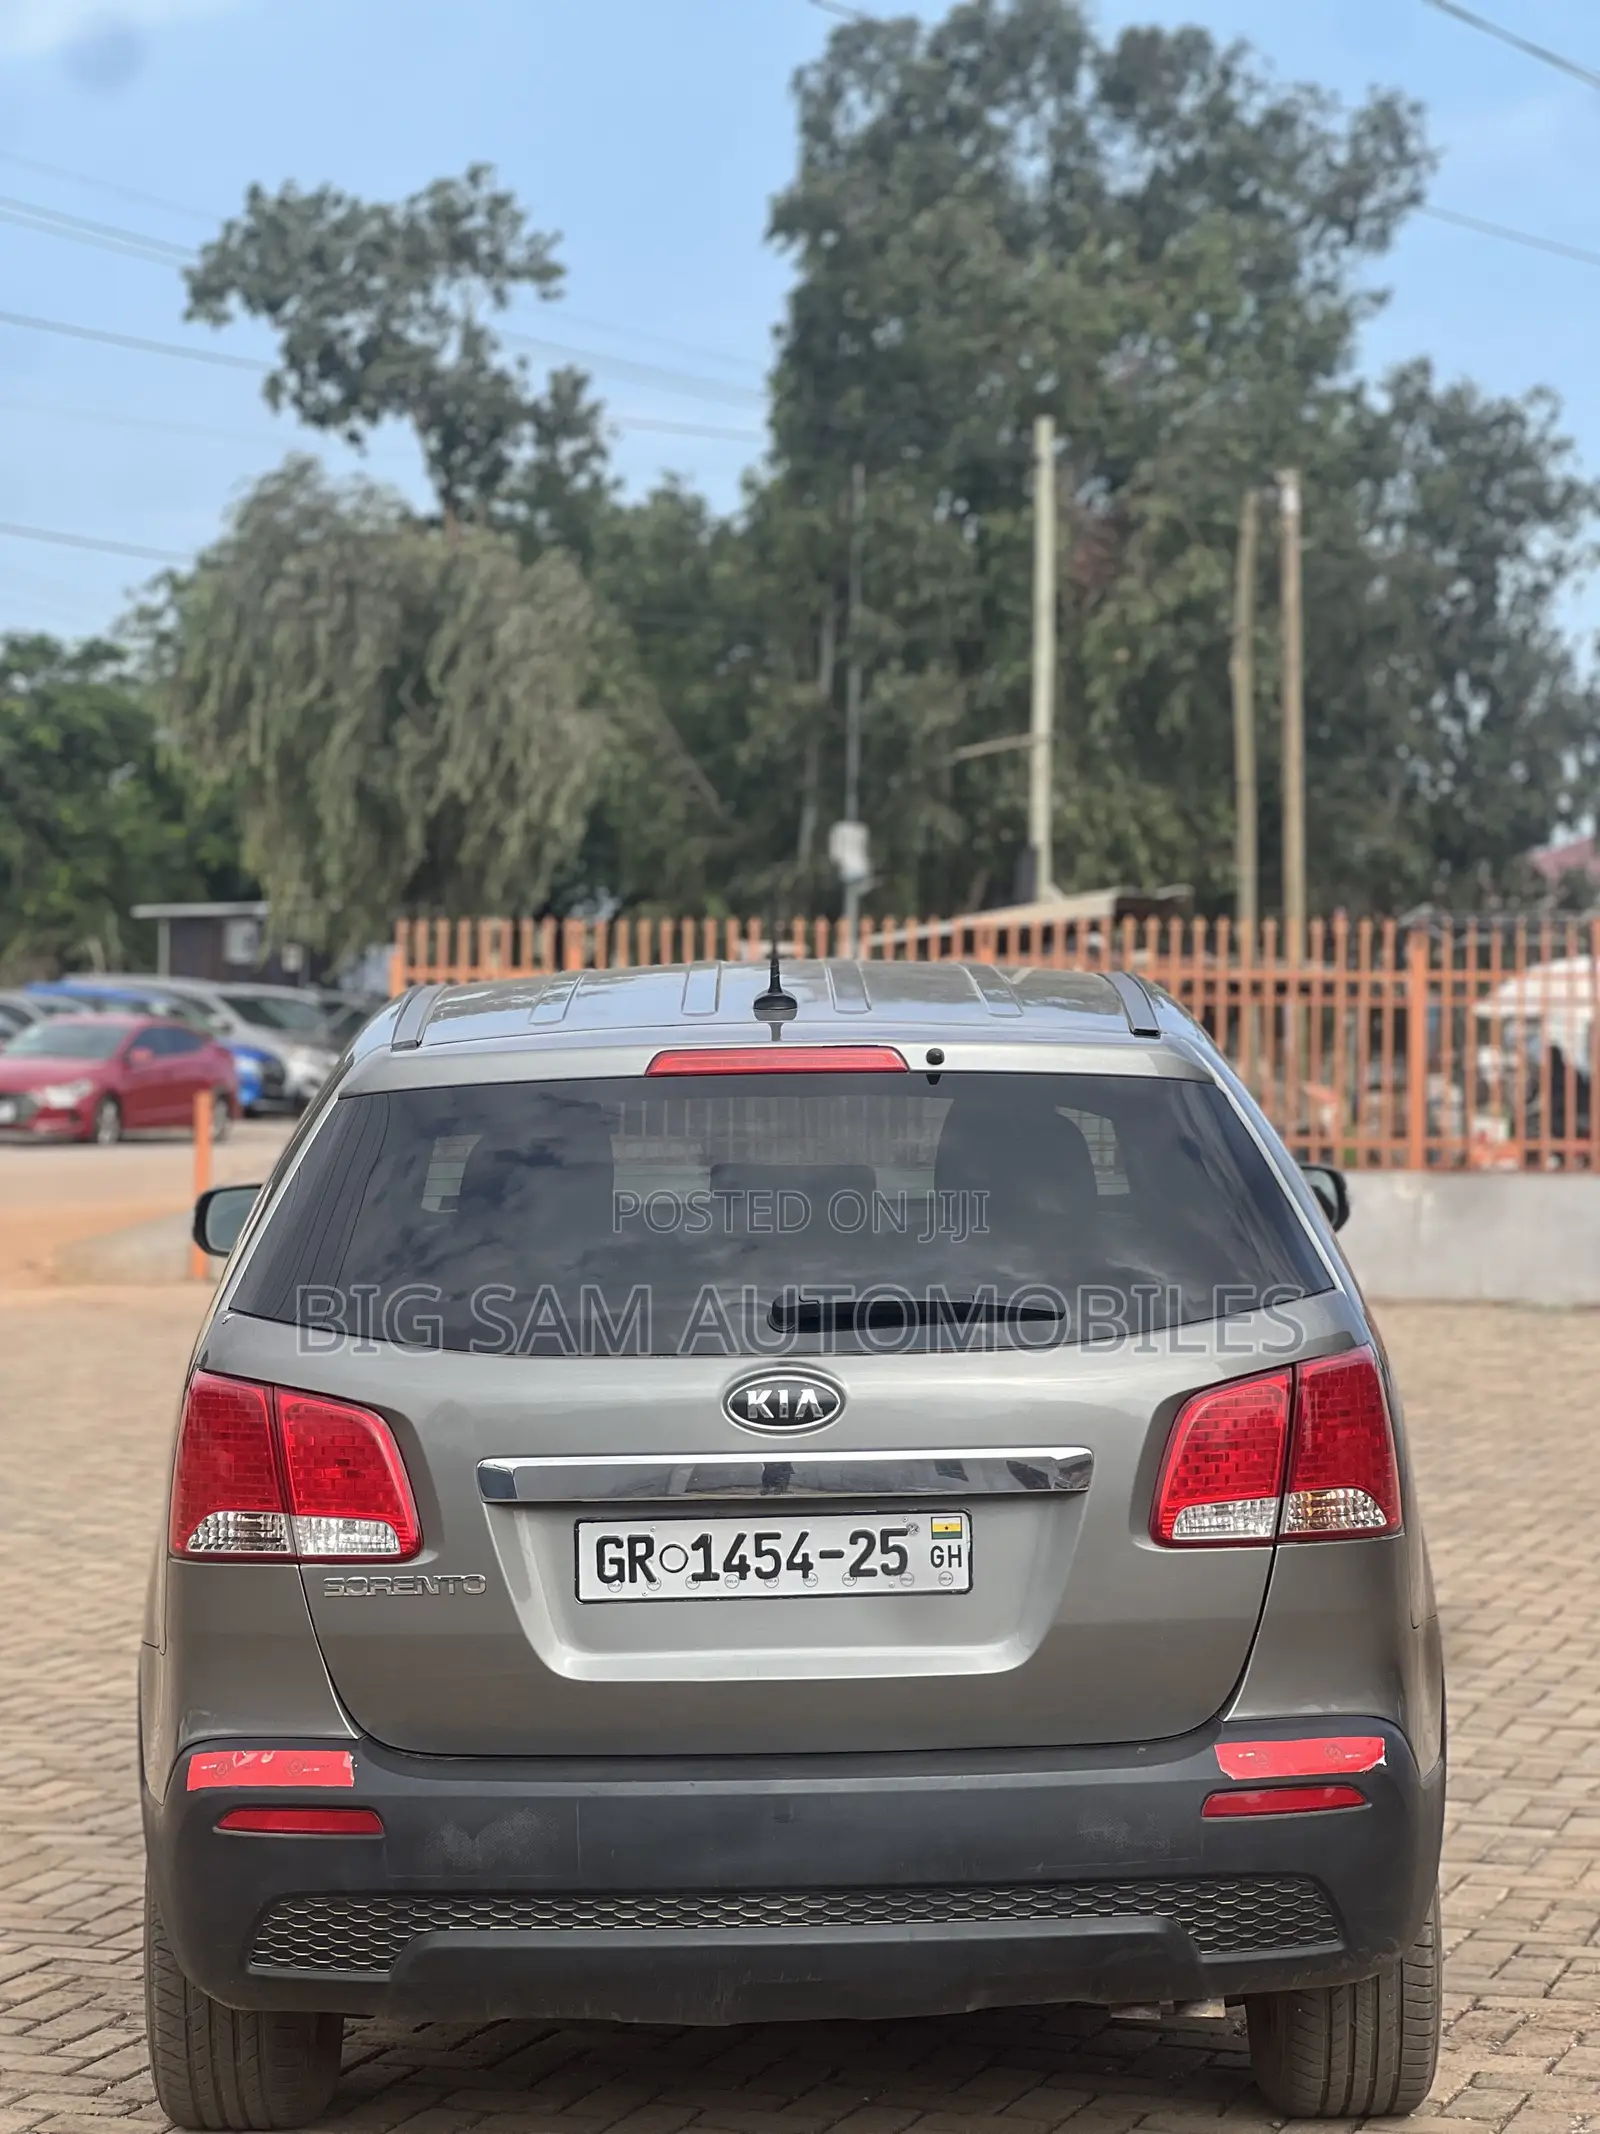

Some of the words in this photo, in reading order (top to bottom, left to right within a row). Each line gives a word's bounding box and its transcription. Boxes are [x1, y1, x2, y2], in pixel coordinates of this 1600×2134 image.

[745, 1388, 824, 1419] KIA
[930, 1544, 963, 1569] GH
[323, 1574, 487, 1598] SORENTO
